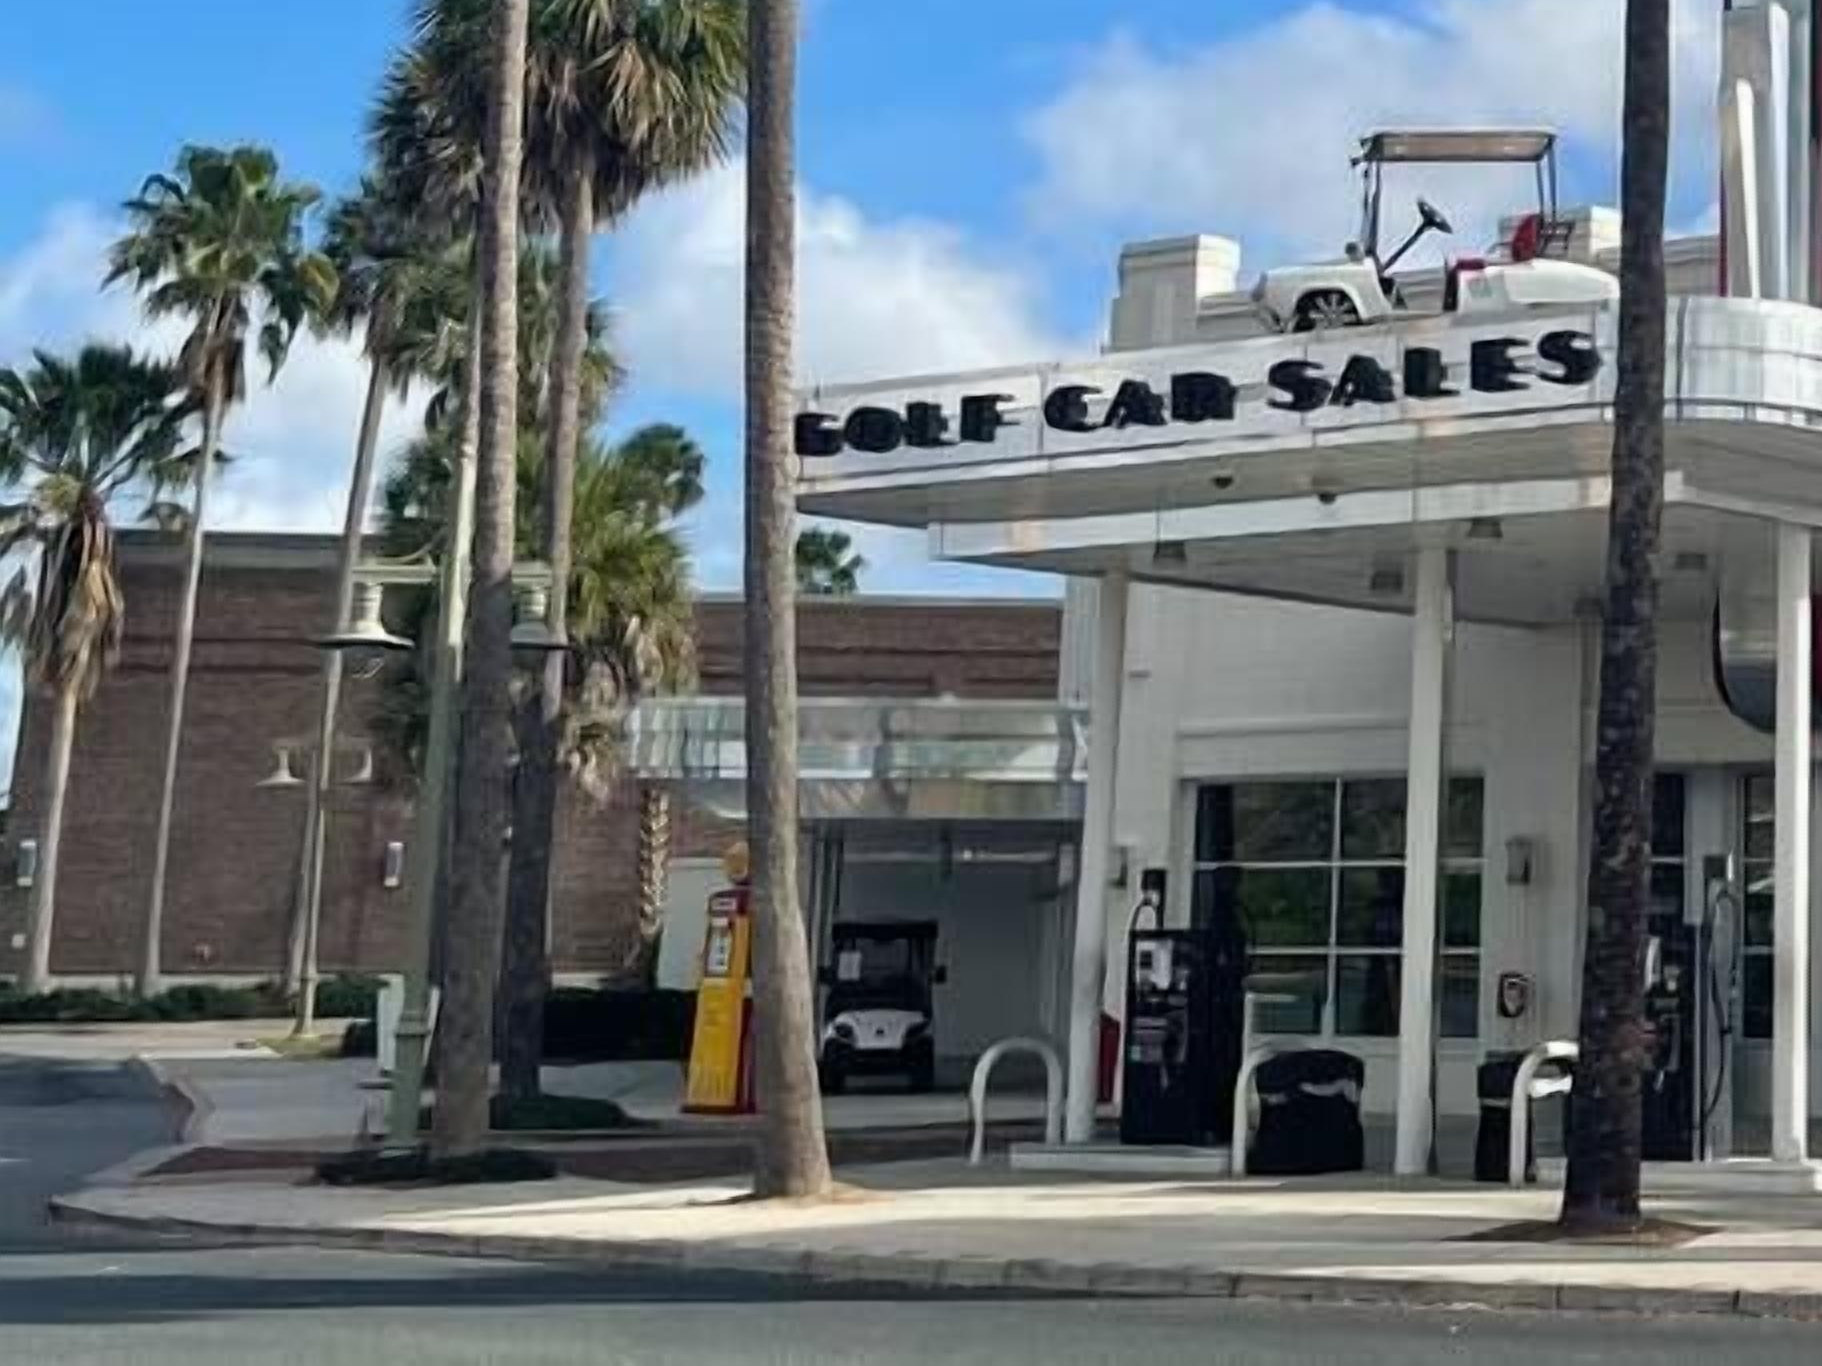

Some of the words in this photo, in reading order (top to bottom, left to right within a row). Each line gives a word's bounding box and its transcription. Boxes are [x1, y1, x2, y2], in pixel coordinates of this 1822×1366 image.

[794, 393, 1021, 457] GOLF
[1043, 371, 1237, 433] CAR
[1266, 329, 1603, 412] SALES
